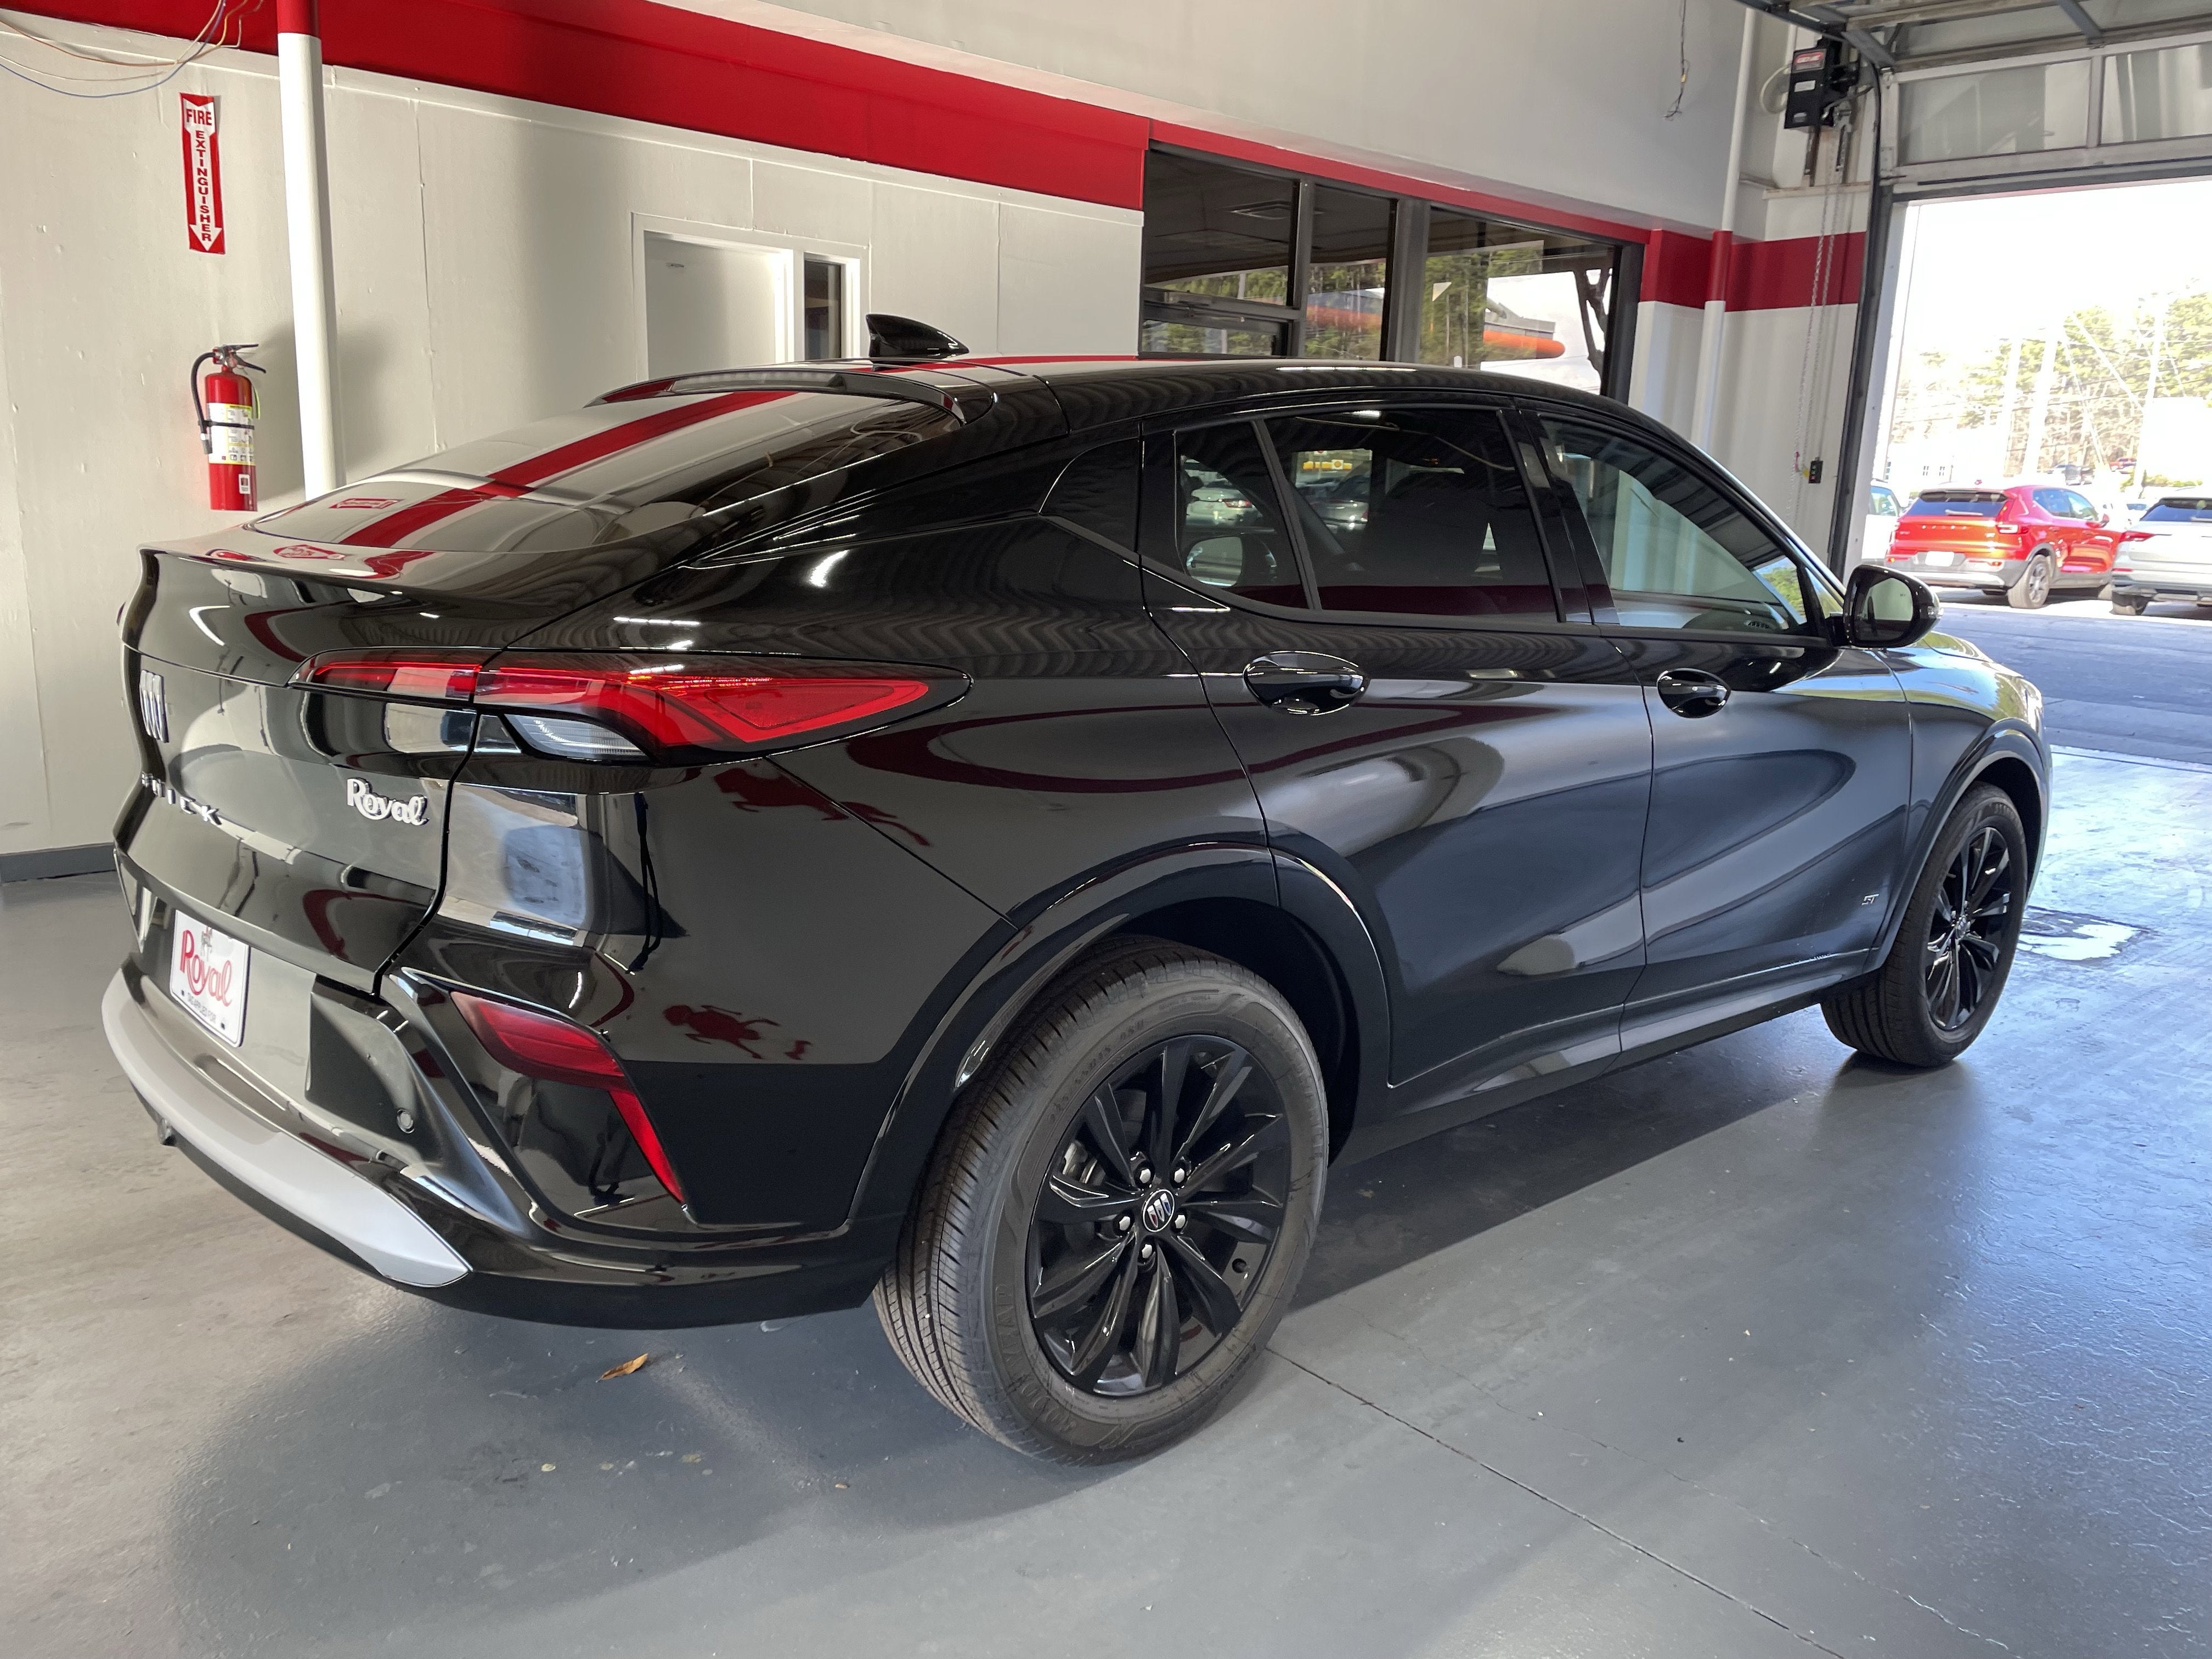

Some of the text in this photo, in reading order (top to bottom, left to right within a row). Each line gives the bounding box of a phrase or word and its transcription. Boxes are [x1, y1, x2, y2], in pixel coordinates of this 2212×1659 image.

[186, 109, 212, 126] FIRE
[195, 130, 212, 242] EXTINGUISHER
[347, 776, 430, 826] Royal
[179, 929, 233, 1007] Royal
